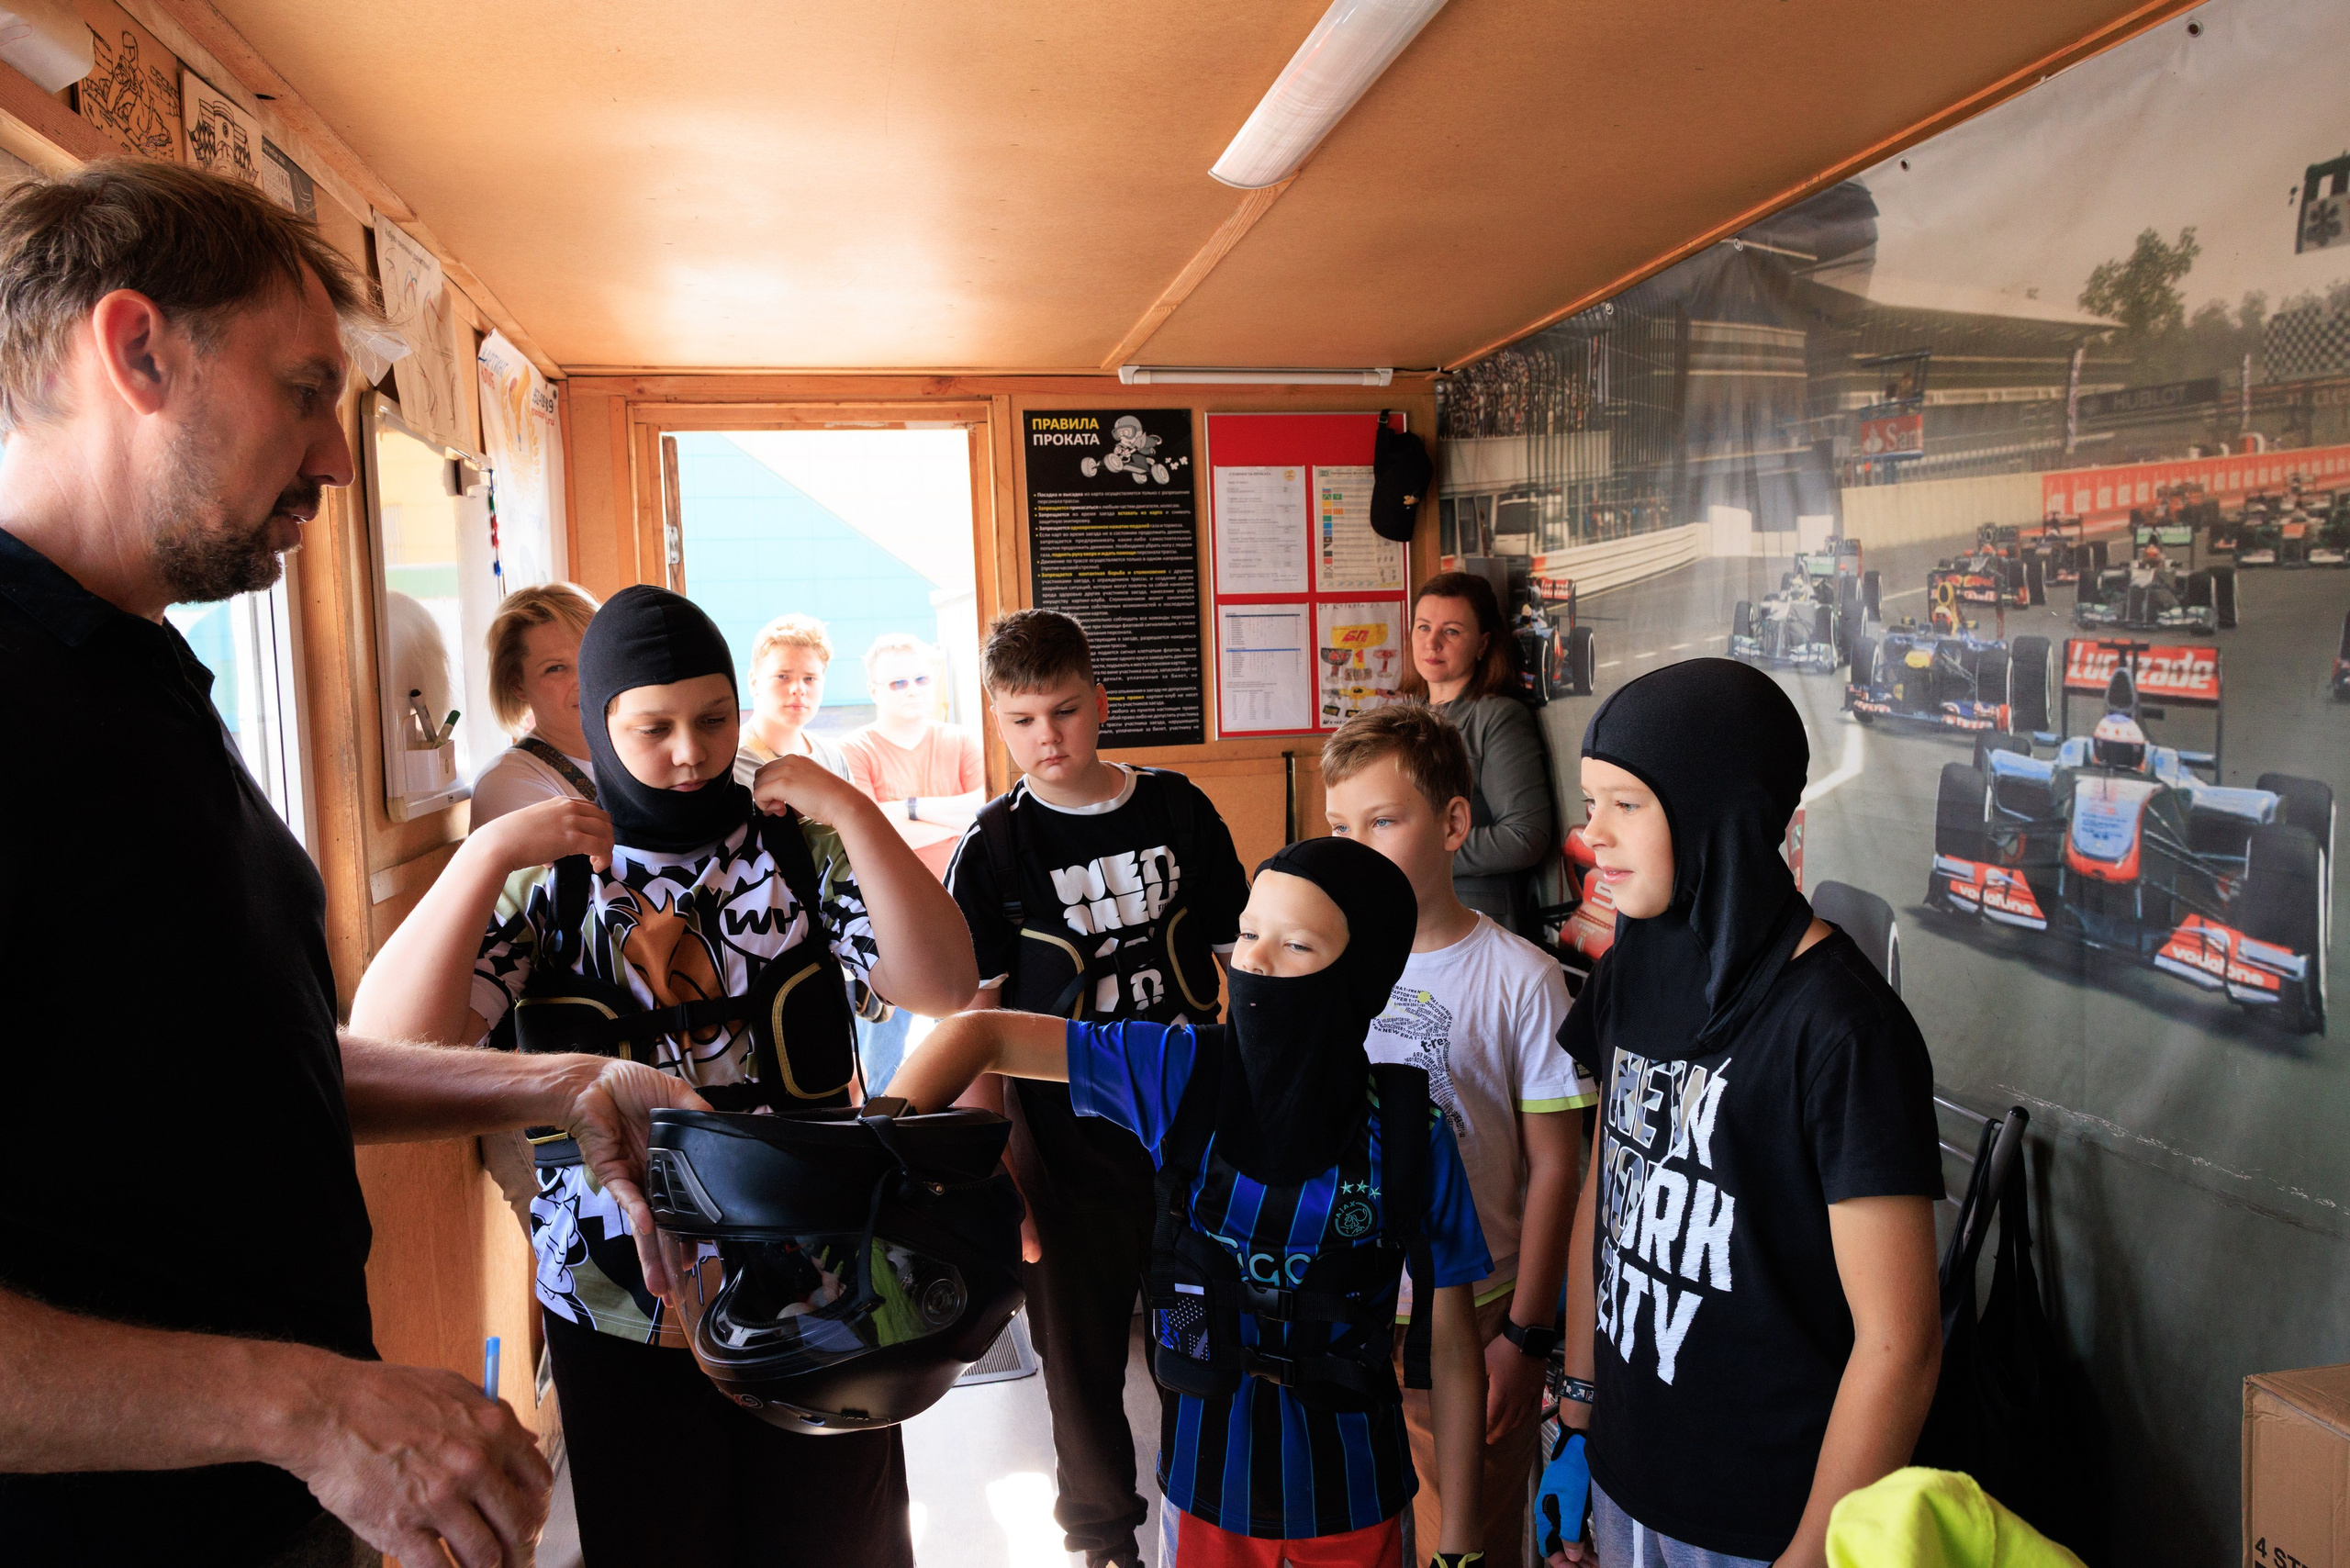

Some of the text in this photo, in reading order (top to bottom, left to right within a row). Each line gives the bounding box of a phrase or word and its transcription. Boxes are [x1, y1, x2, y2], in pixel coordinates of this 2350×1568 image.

[1032, 418, 1100, 431] ПРАВИЛА
[1033, 433, 1101, 446] ПРОКАТА
[1382, 1026, 1399, 1035] NEW
[1400, 1032, 1414, 1040] ERA
[1420, 1037, 1448, 1053] t-rex
[1608, 1046, 1731, 1170] NEW
[1336, 1201, 1356, 1219] AJAX
[2255, 1537, 2267, 1559] 4
